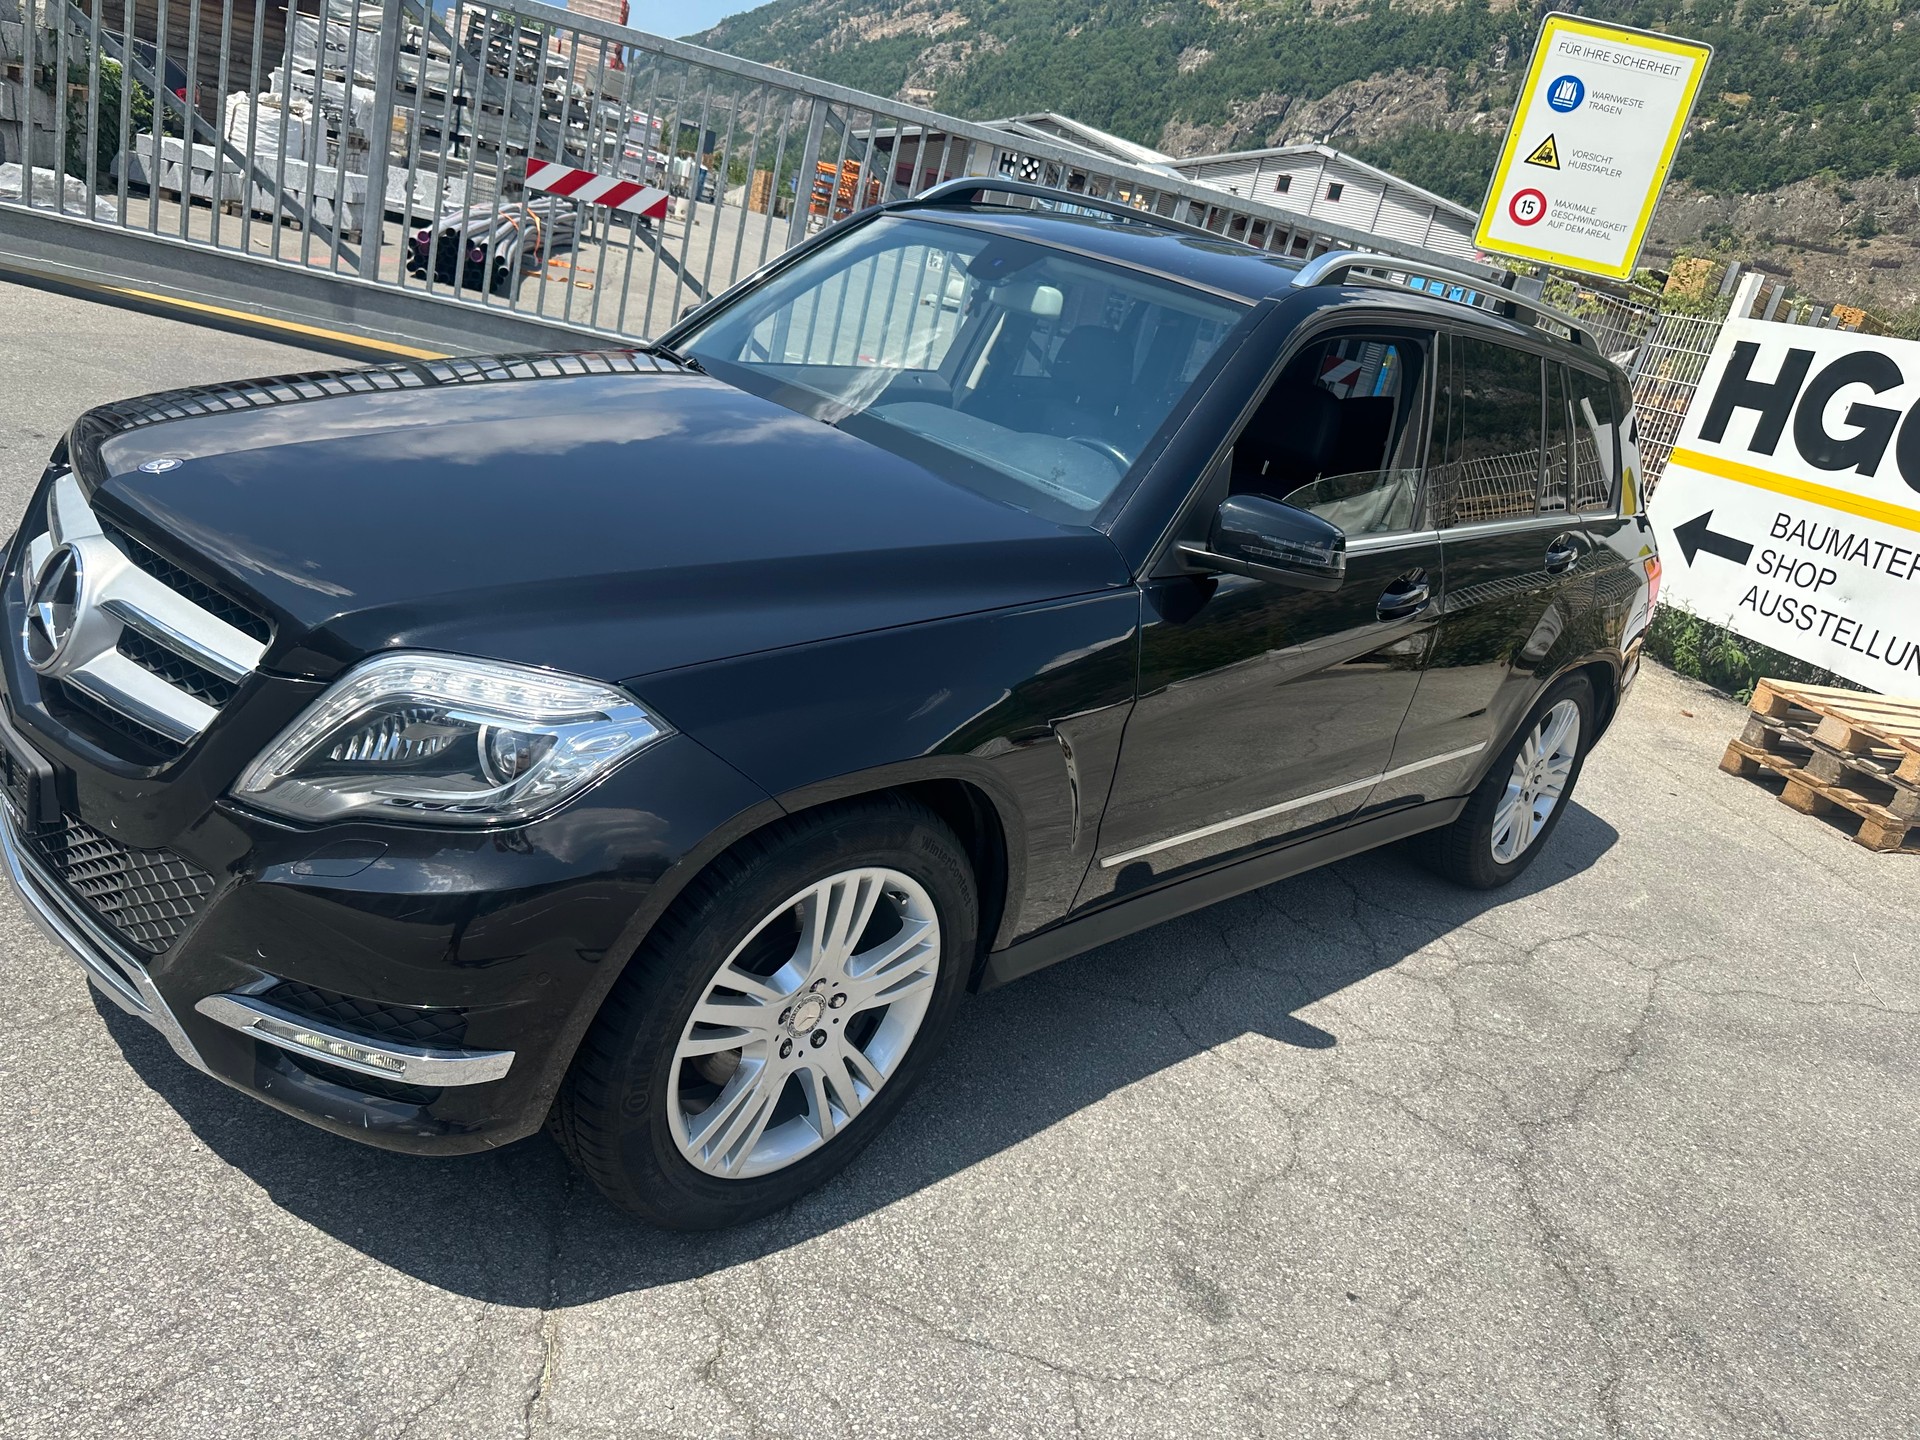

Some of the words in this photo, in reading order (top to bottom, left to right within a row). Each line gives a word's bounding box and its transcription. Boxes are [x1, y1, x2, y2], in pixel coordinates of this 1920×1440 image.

[1559, 42, 1581, 55] FÜR
[1583, 48, 1611, 62] IHRE
[1612, 54, 1681, 76] SICHERHEIT
[1589, 101, 1622, 115] TRAGEN
[1592, 90, 1644, 108] WARNWESTE
[1572, 149, 1613, 165] VORSICHT
[1568, 160, 1622, 178] HUBSTAPLER
[1521, 200, 1536, 215] 15
[1554, 199, 1597, 215] MAXIMALE
[1547, 220, 1564, 229] AUF
[1565, 224, 1584, 234] DEM
[1585, 228, 1611, 240] AREAL
[1551, 209, 1627, 233] GESCHWINDIGKEIT
[1697, 340, 1920, 494] HG
[1756, 549, 1837, 592] SHOP
